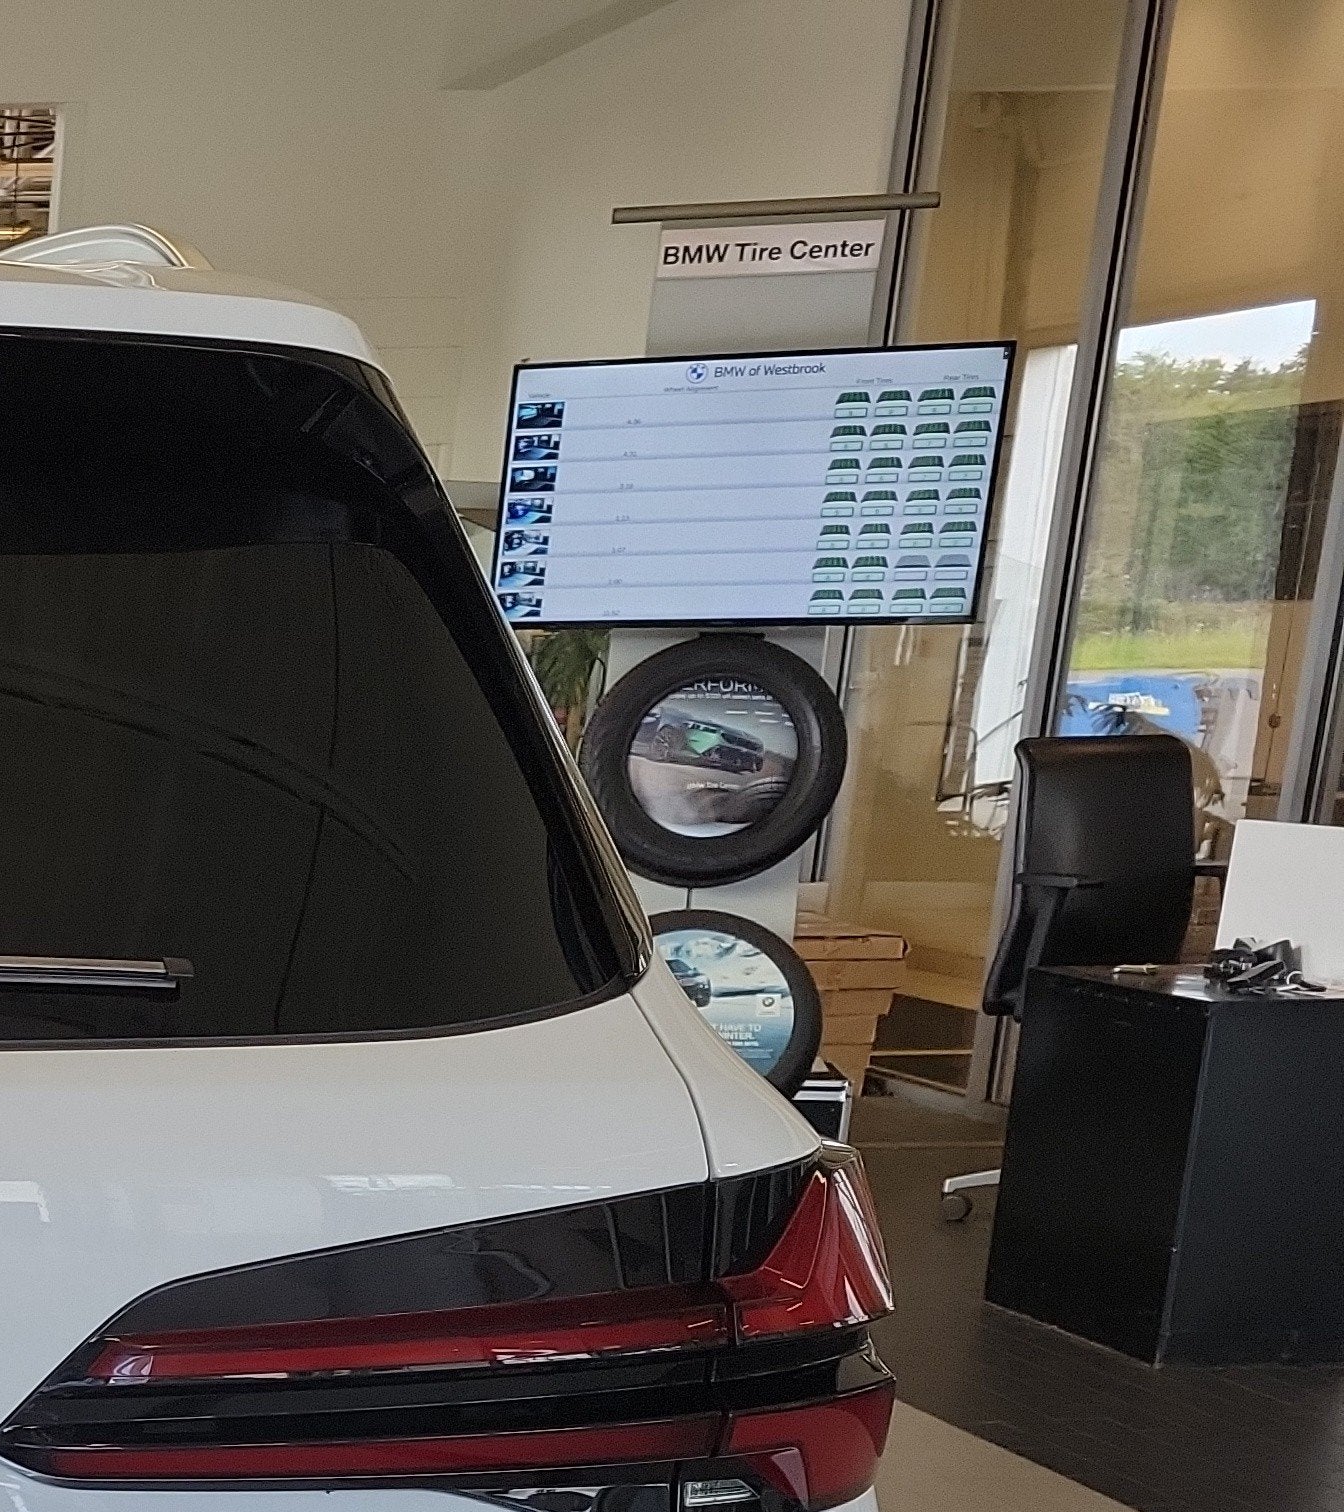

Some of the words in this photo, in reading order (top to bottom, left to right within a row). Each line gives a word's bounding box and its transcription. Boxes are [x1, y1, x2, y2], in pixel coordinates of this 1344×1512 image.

[662, 242, 730, 266] BMW
[734, 241, 783, 262] Tire
[789, 239, 876, 261] Center
[713, 365, 747, 378] BMW
[748, 364, 762, 377] of
[763, 361, 827, 376] Westbrook
